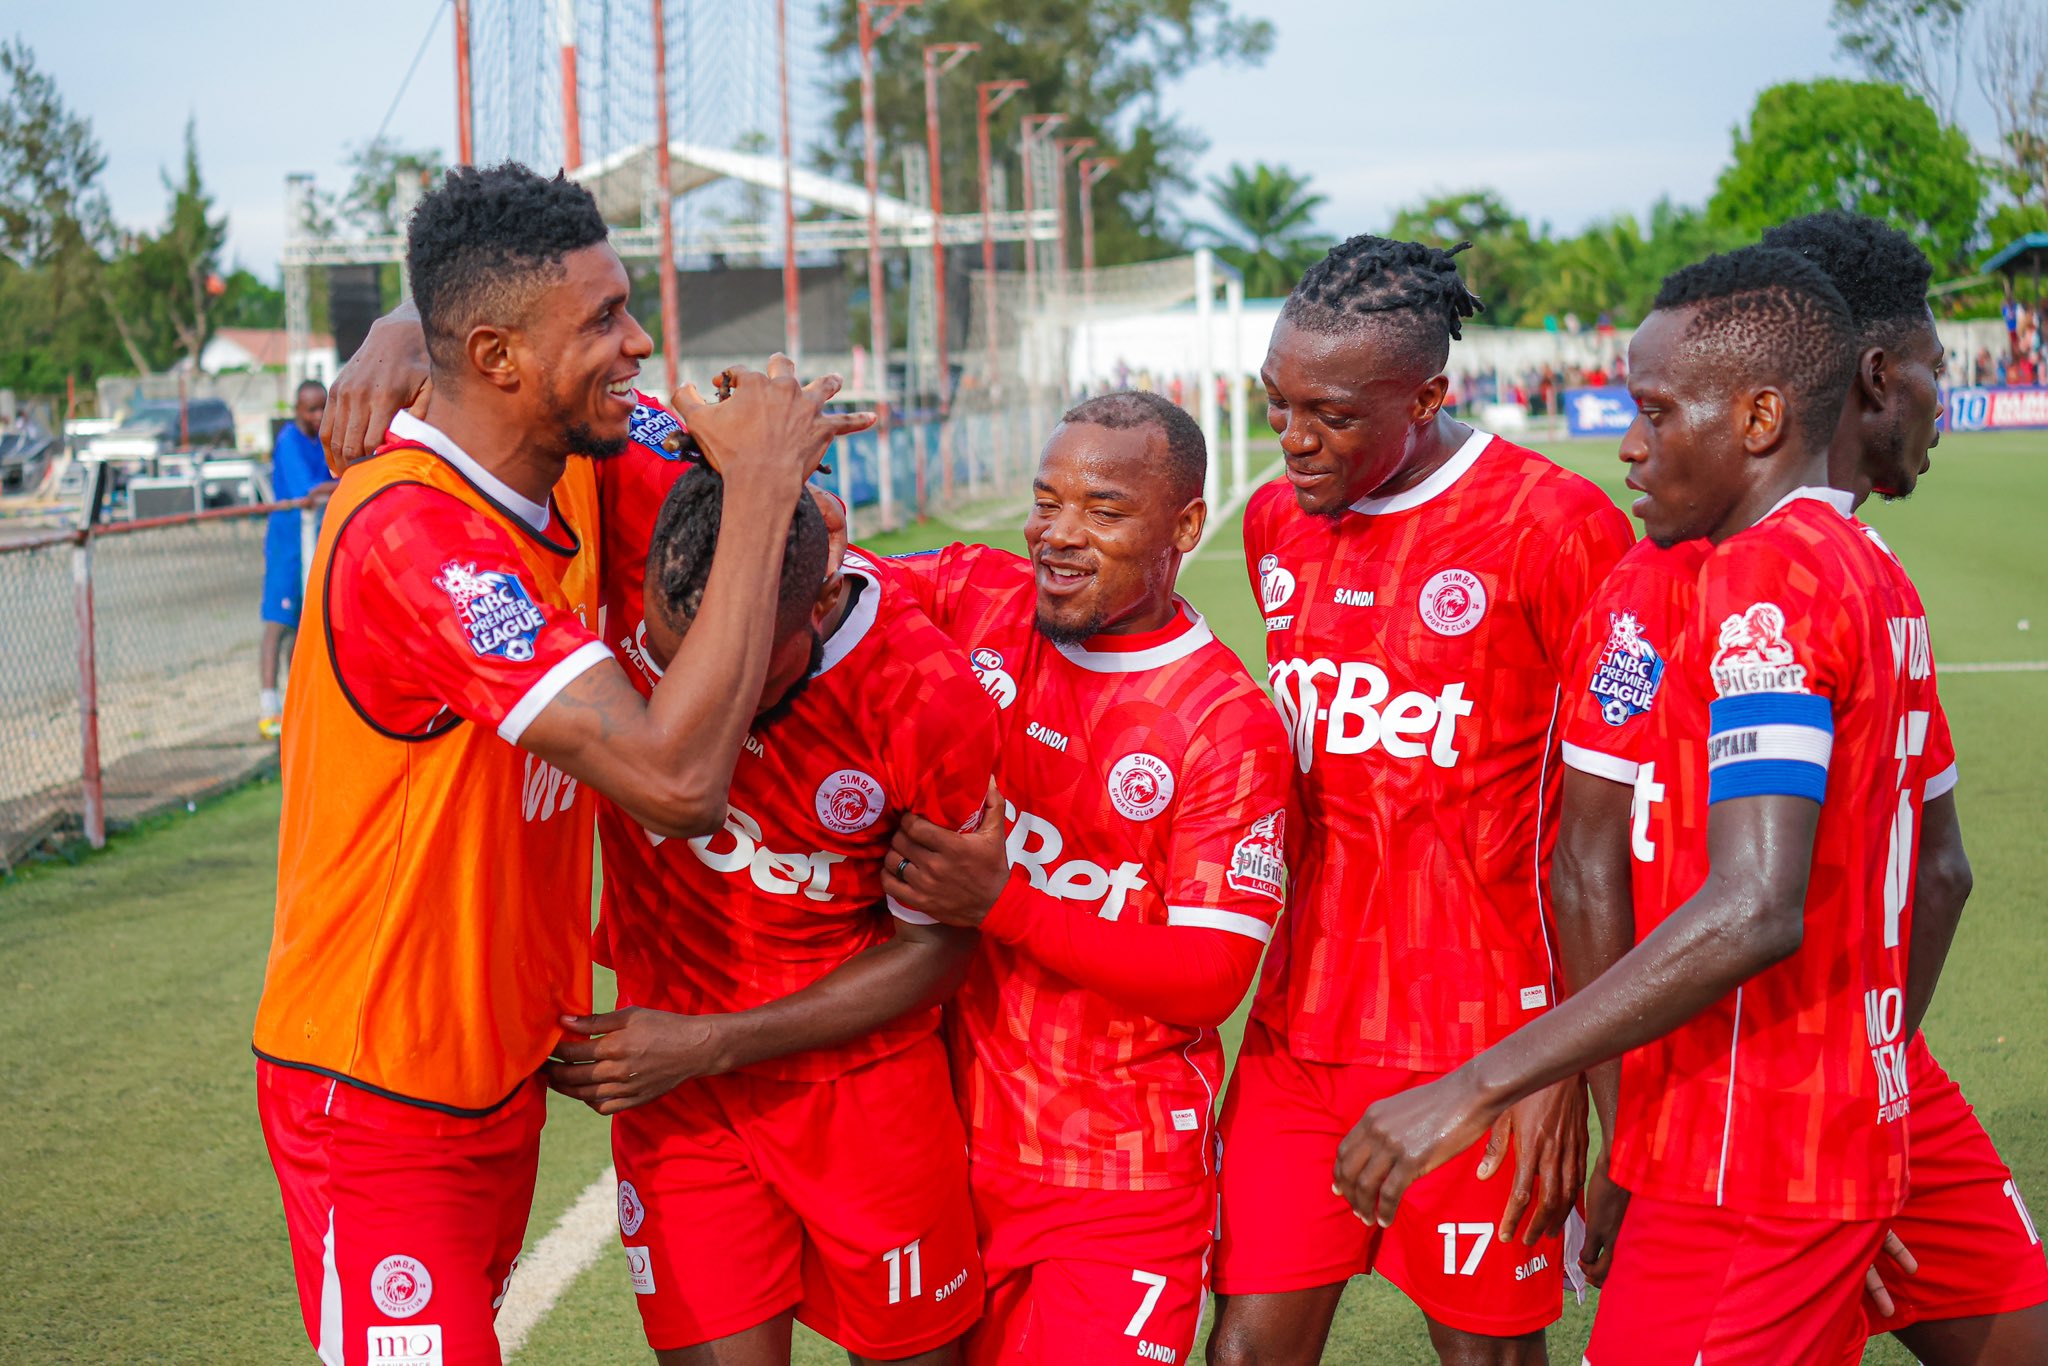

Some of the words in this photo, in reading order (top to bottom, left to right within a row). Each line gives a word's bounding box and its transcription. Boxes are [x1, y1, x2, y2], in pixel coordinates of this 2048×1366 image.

[1442, 573, 1476, 590] SIMBA
[470, 586, 515, 620] NBC
[1333, 588, 1375, 607] SANDA
[470, 599, 530, 638] PREMIER
[471, 607, 545, 655] LEAGUE
[1425, 610, 1449, 631] SPORTS
[1451, 619, 1471, 631] CLUB
[1599, 665, 1653, 694] PREMIER
[1611, 652, 1651, 678] NBC
[1589, 674, 1654, 711] LEAGUE
[1716, 666, 1801, 698] Pilsner
[1026, 721, 1069, 752] SANDA
[1708, 732, 1757, 763] APTAIN
[1134, 756, 1167, 781] SIMBA
[839, 774, 875, 796] SIMBA
[1111, 787, 1134, 815] SPORTS
[1135, 807, 1154, 817] CLUB
[1004, 799, 1147, 921] Bet
[1251, 880, 1277, 894] LAGER
[1864, 987, 1902, 1047] MO
[1871, 1041, 1909, 1106] DEW
[1438, 1222, 1494, 1275] 17
[383, 1260, 415, 1272] SIMBA
[883, 1239, 921, 1304] 11
[1515, 1253, 1548, 1281] SANDA
[935, 1268, 968, 1302] SANDA
[1124, 1269, 1167, 1336] 7
[1137, 1340, 1176, 1364] SANDA
